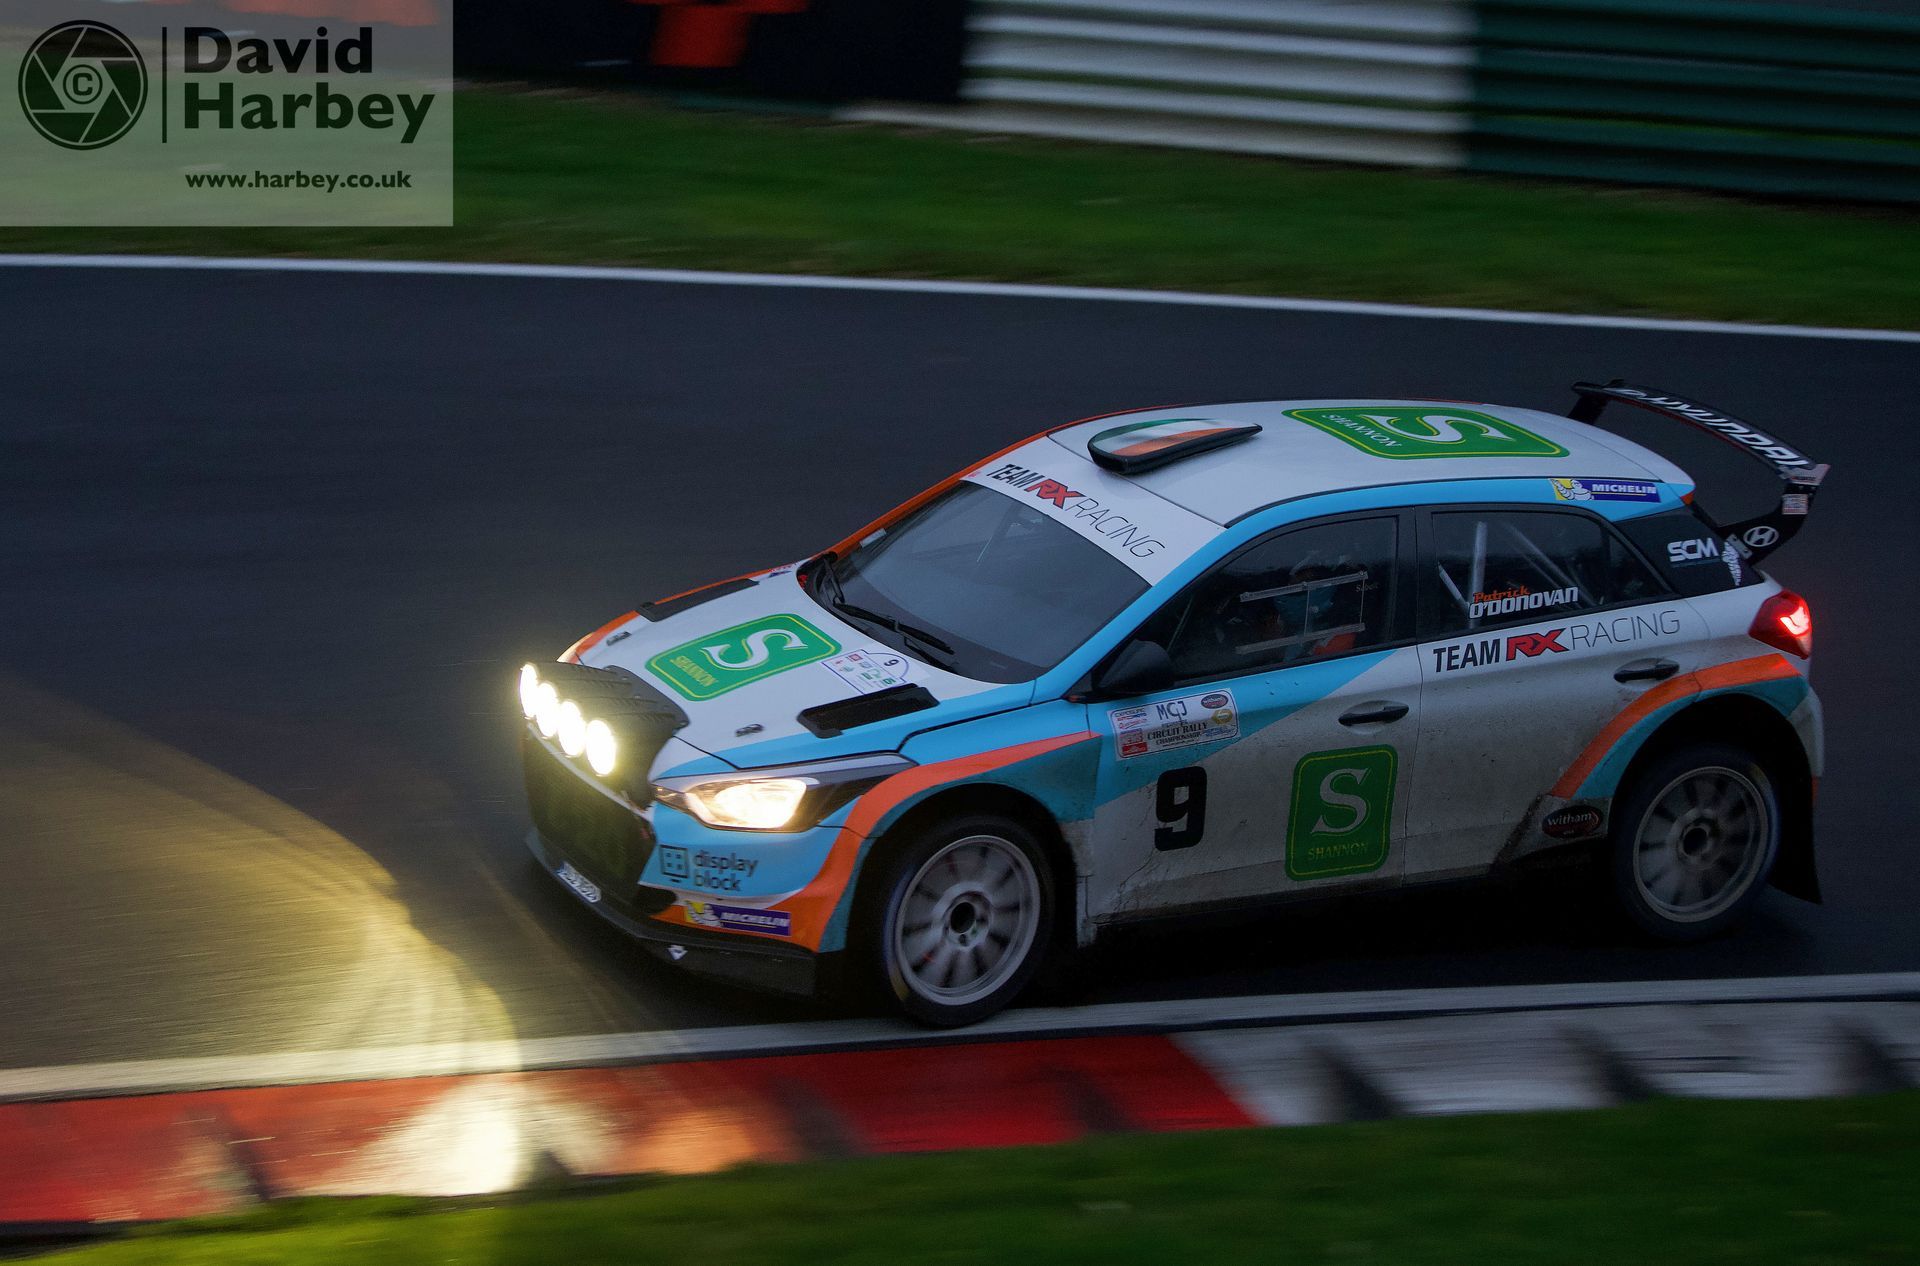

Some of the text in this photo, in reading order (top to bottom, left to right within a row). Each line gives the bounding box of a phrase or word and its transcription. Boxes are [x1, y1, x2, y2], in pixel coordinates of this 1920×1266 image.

[1321, 414, 1402, 447] SHANNON
[1638, 396, 1809, 466] HYUNDAI
[1592, 483, 1657, 494] MICHELIN
[986, 464, 1165, 558] TEAM RX RACING
[1667, 537, 1719, 562] SCM
[1473, 585, 1531, 603] Patrick
[1433, 610, 1680, 672] TEAM RX RACING
[1147, 726, 1182, 740] CIRCUIT
[1182, 721, 1207, 735] RALLY
[1154, 766, 1207, 852] 9
[693, 849, 758, 877] display
[1308, 841, 1369, 862] SHANNON
[693, 868, 741, 891] block
[721, 912, 790, 927] MICHELIN
